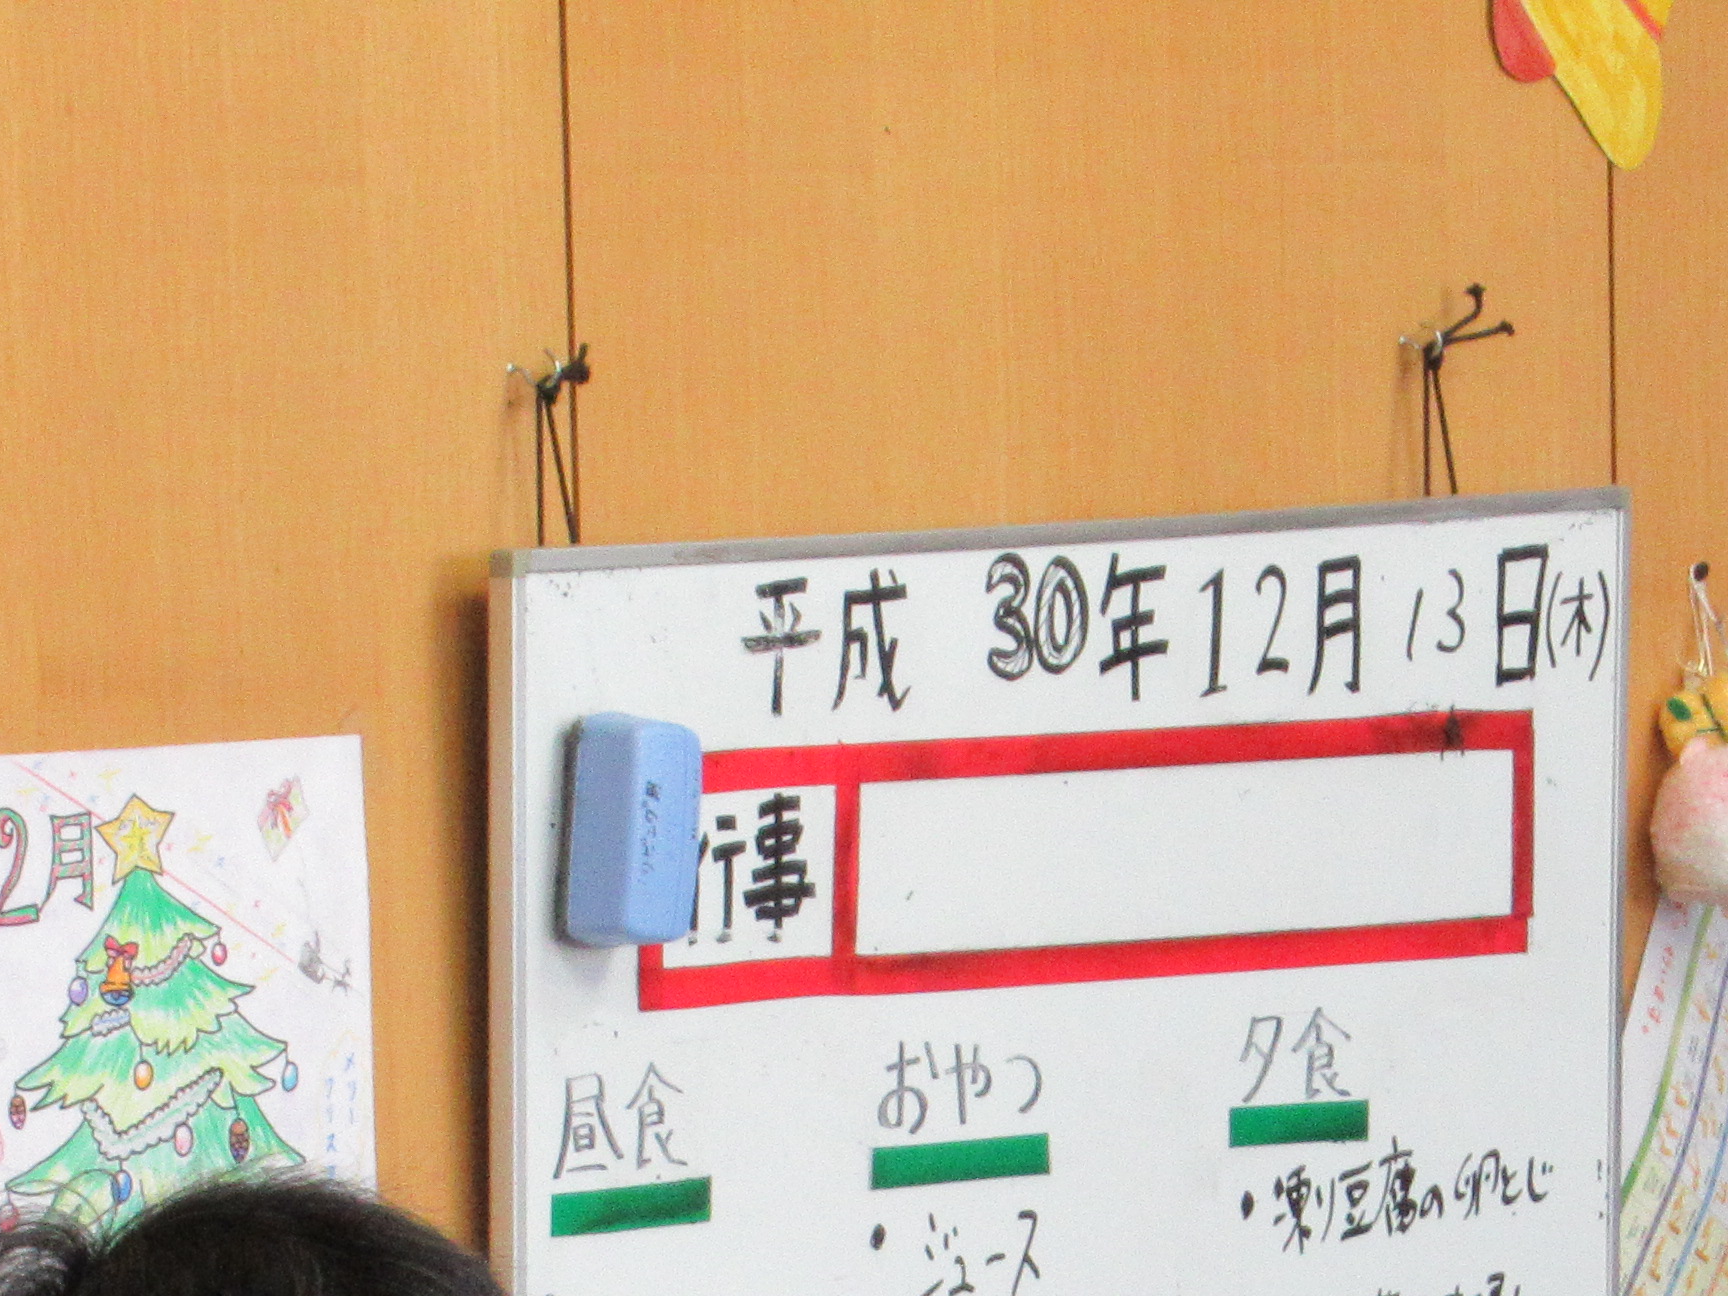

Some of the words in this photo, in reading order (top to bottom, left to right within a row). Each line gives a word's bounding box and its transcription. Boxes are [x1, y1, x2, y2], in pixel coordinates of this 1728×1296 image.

[741, 570, 911, 716] 平成
[879, 1041, 1044, 1135] おやつ
[1239, 1006, 1353, 1102] 夕食
[553, 1060, 688, 1180] 昼食
